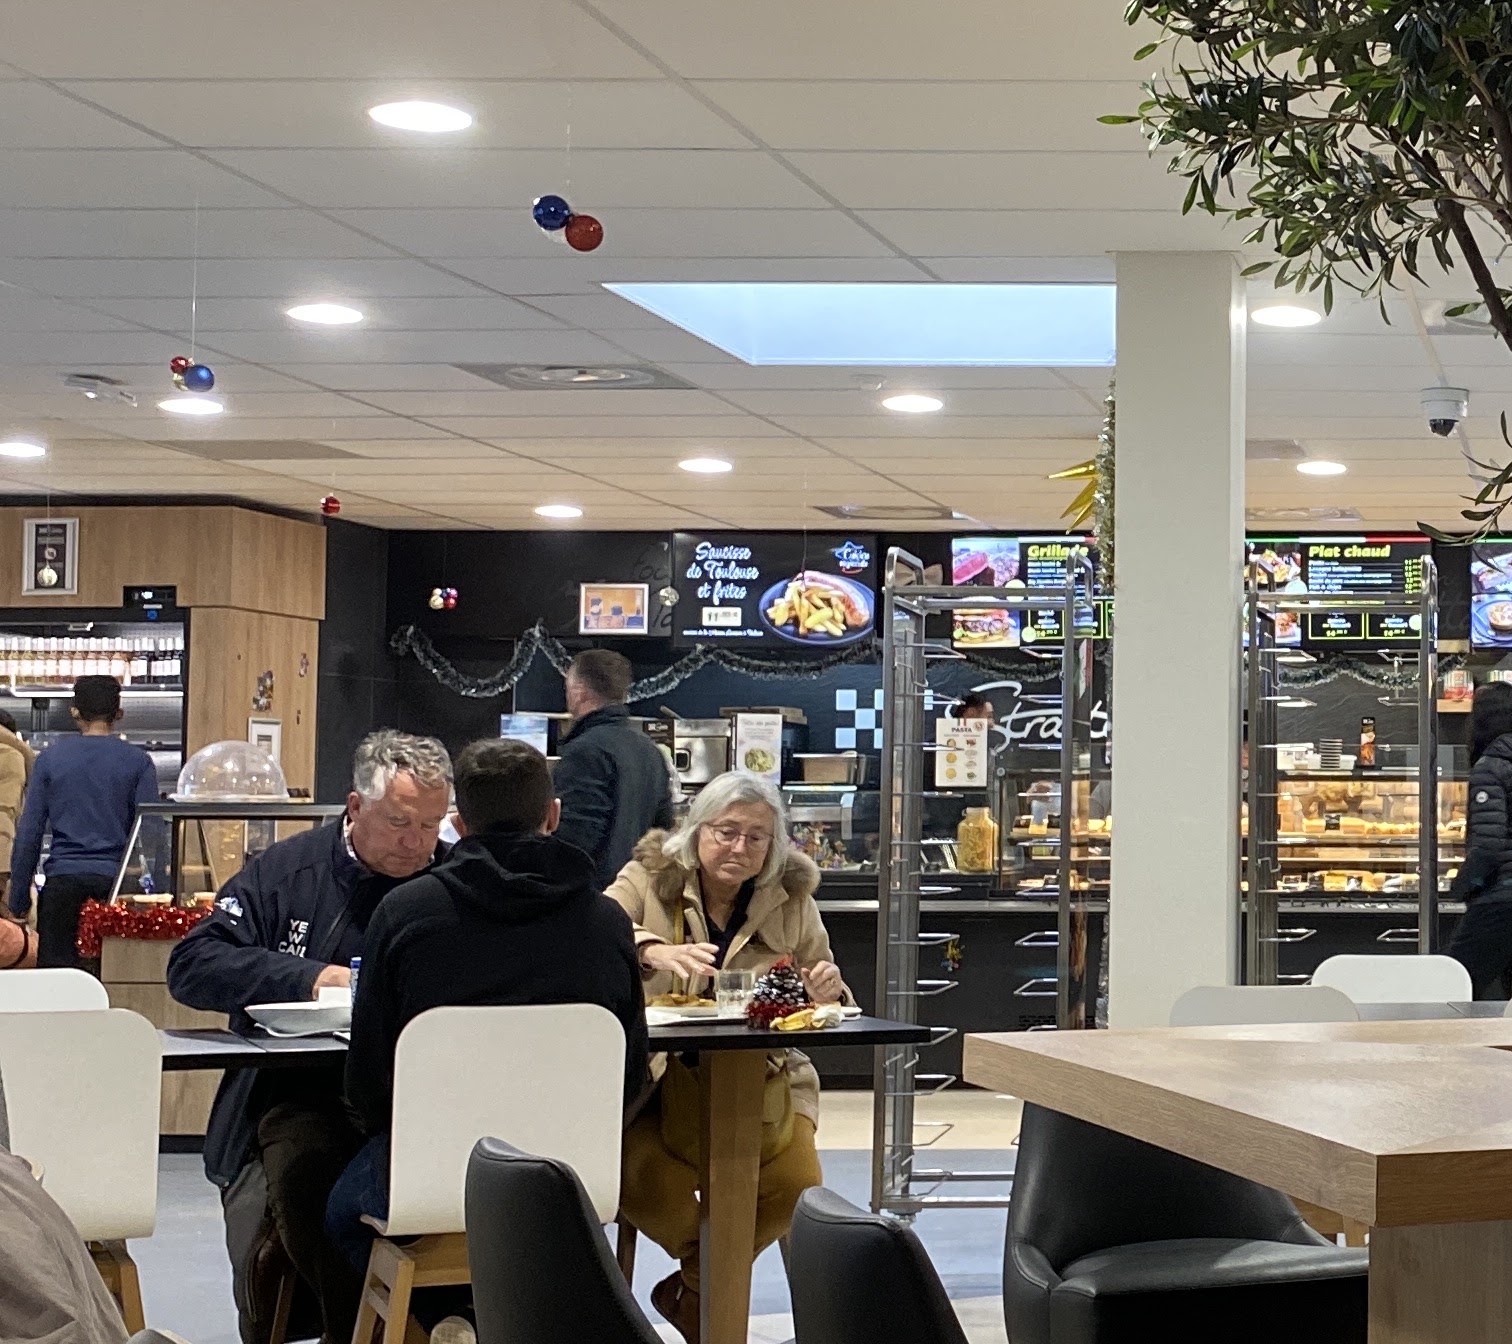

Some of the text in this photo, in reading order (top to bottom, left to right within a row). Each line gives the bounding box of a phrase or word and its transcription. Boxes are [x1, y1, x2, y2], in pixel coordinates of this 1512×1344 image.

[695, 541, 752, 561] Saucisse
[1308, 544, 1392, 558] Plat chaud
[686, 560, 760, 580] de Toulouse
[697, 580, 747, 605] et frites
